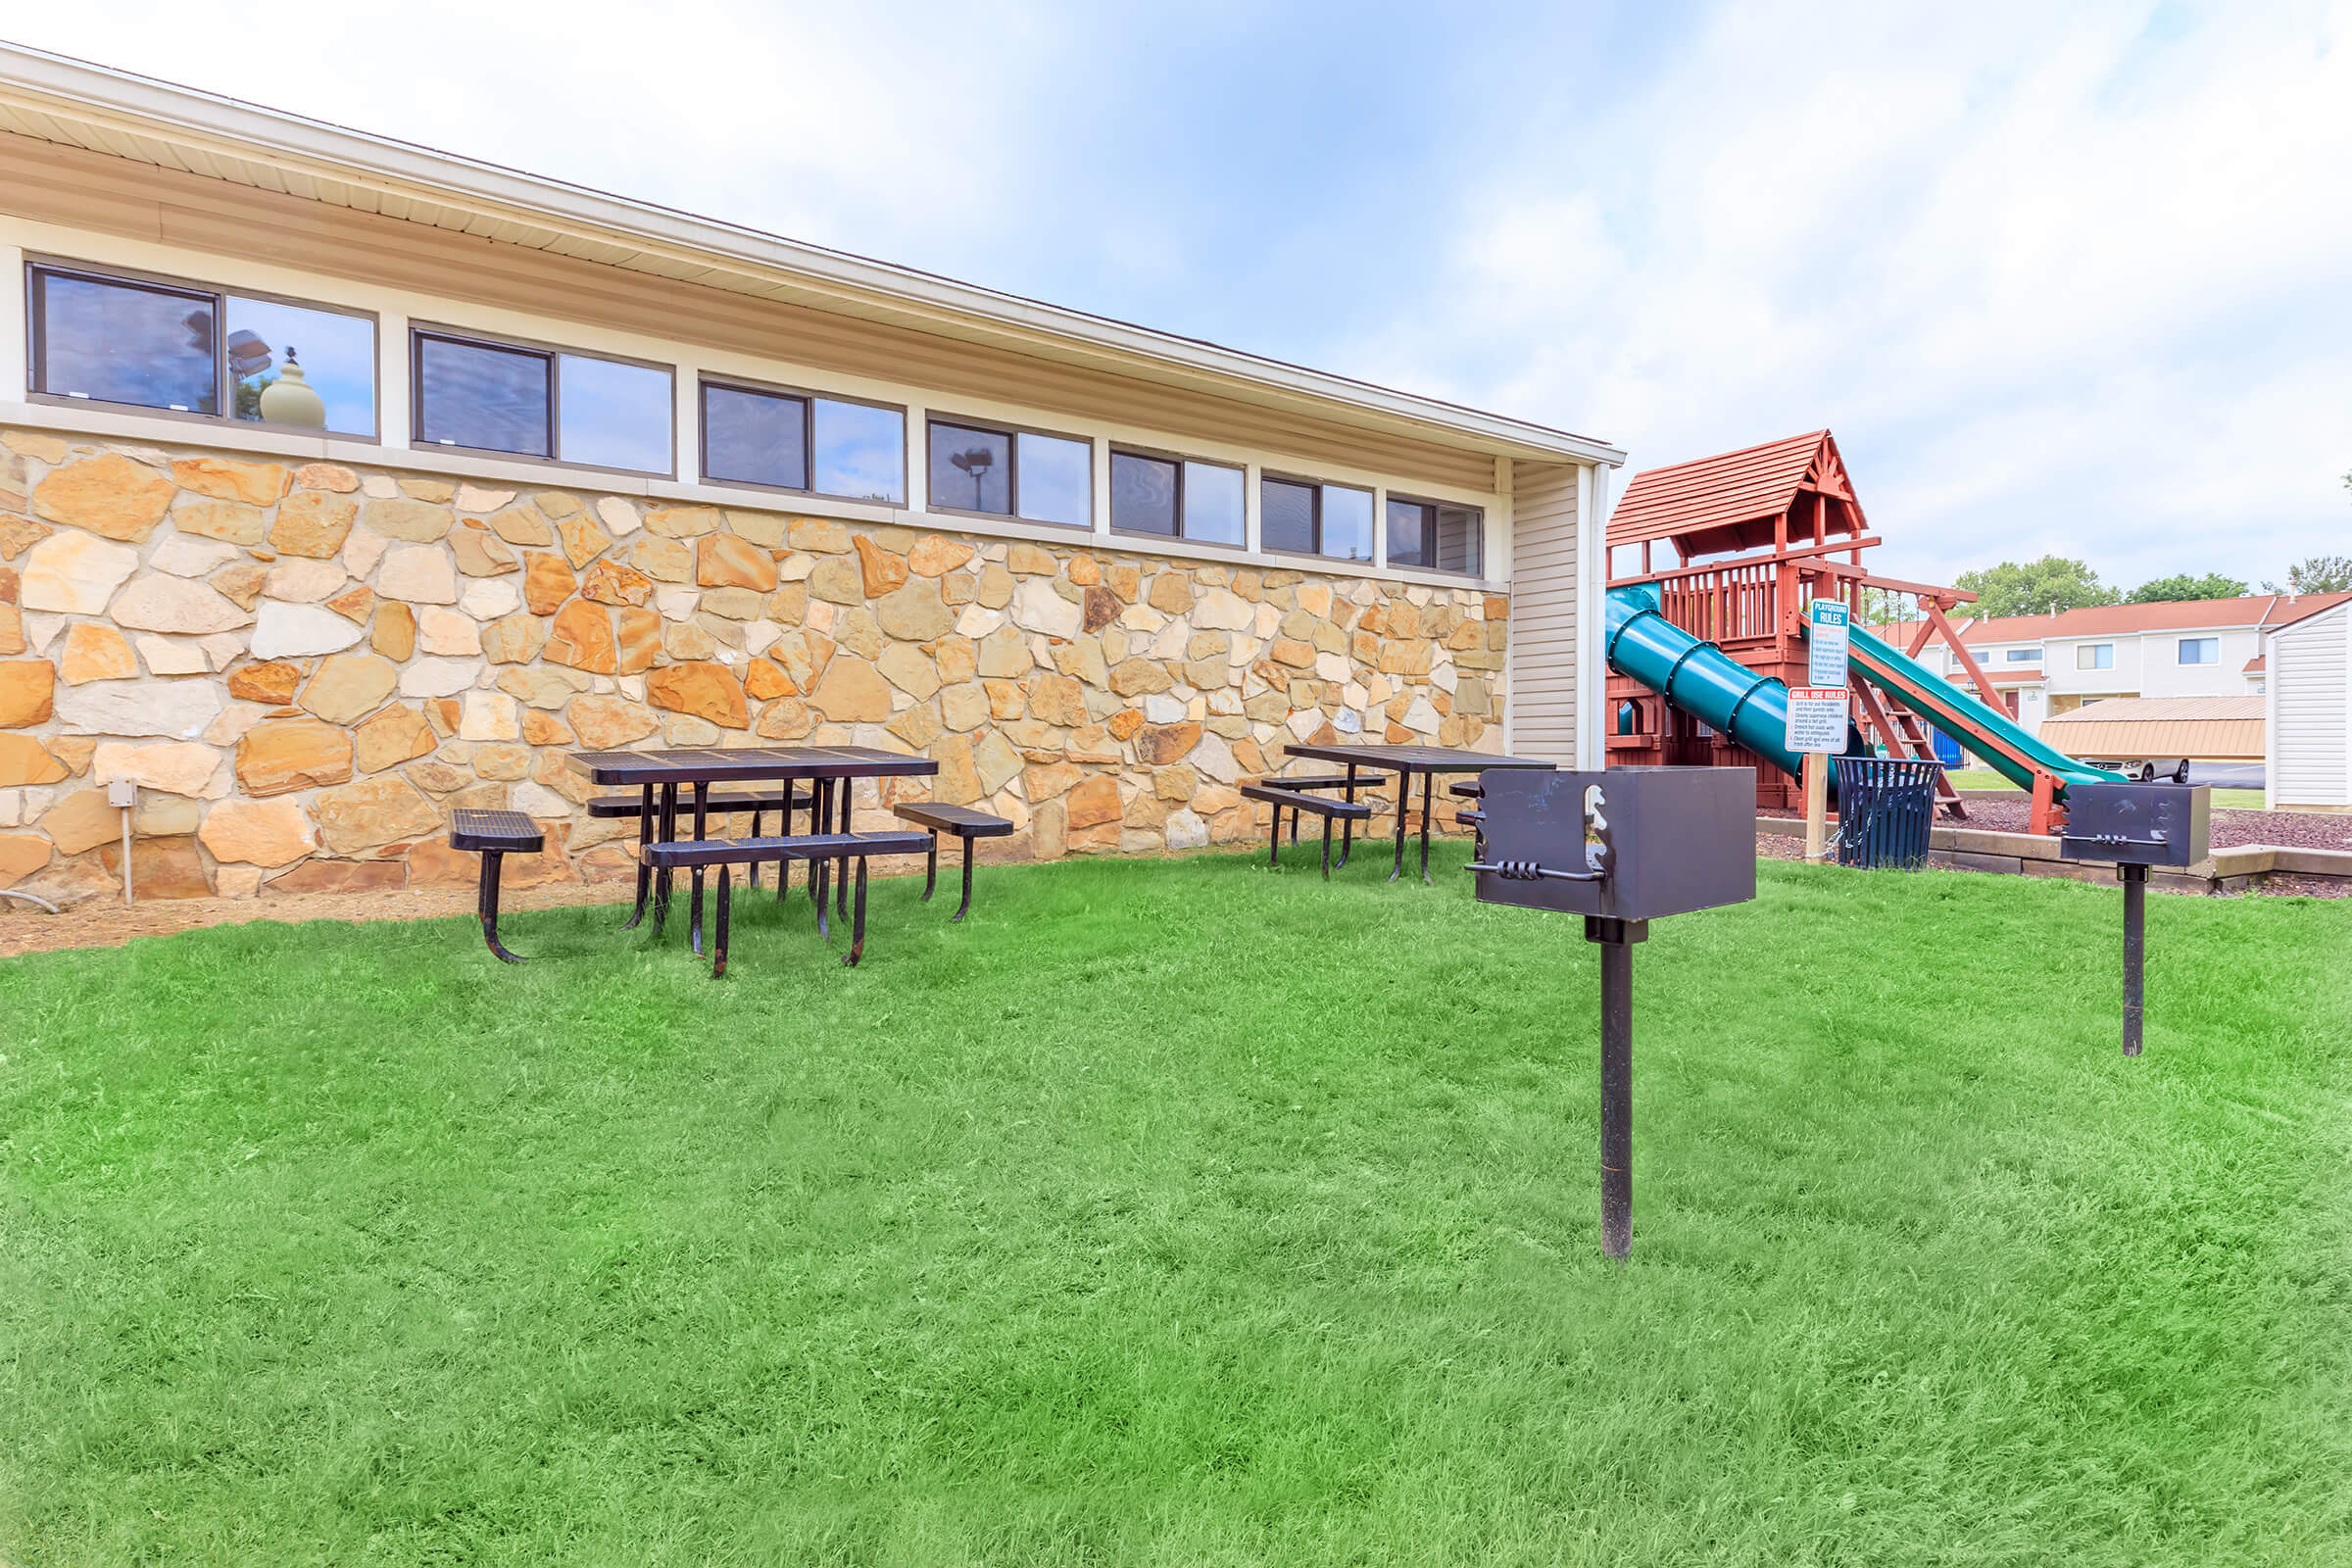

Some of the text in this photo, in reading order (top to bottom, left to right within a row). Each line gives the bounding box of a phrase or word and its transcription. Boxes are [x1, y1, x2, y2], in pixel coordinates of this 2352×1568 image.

[1814, 602, 1846, 613] PLAYGROUND
[1820, 611, 1842, 624] RULES
[1791, 690, 1845, 699] GRILL USE RULES
